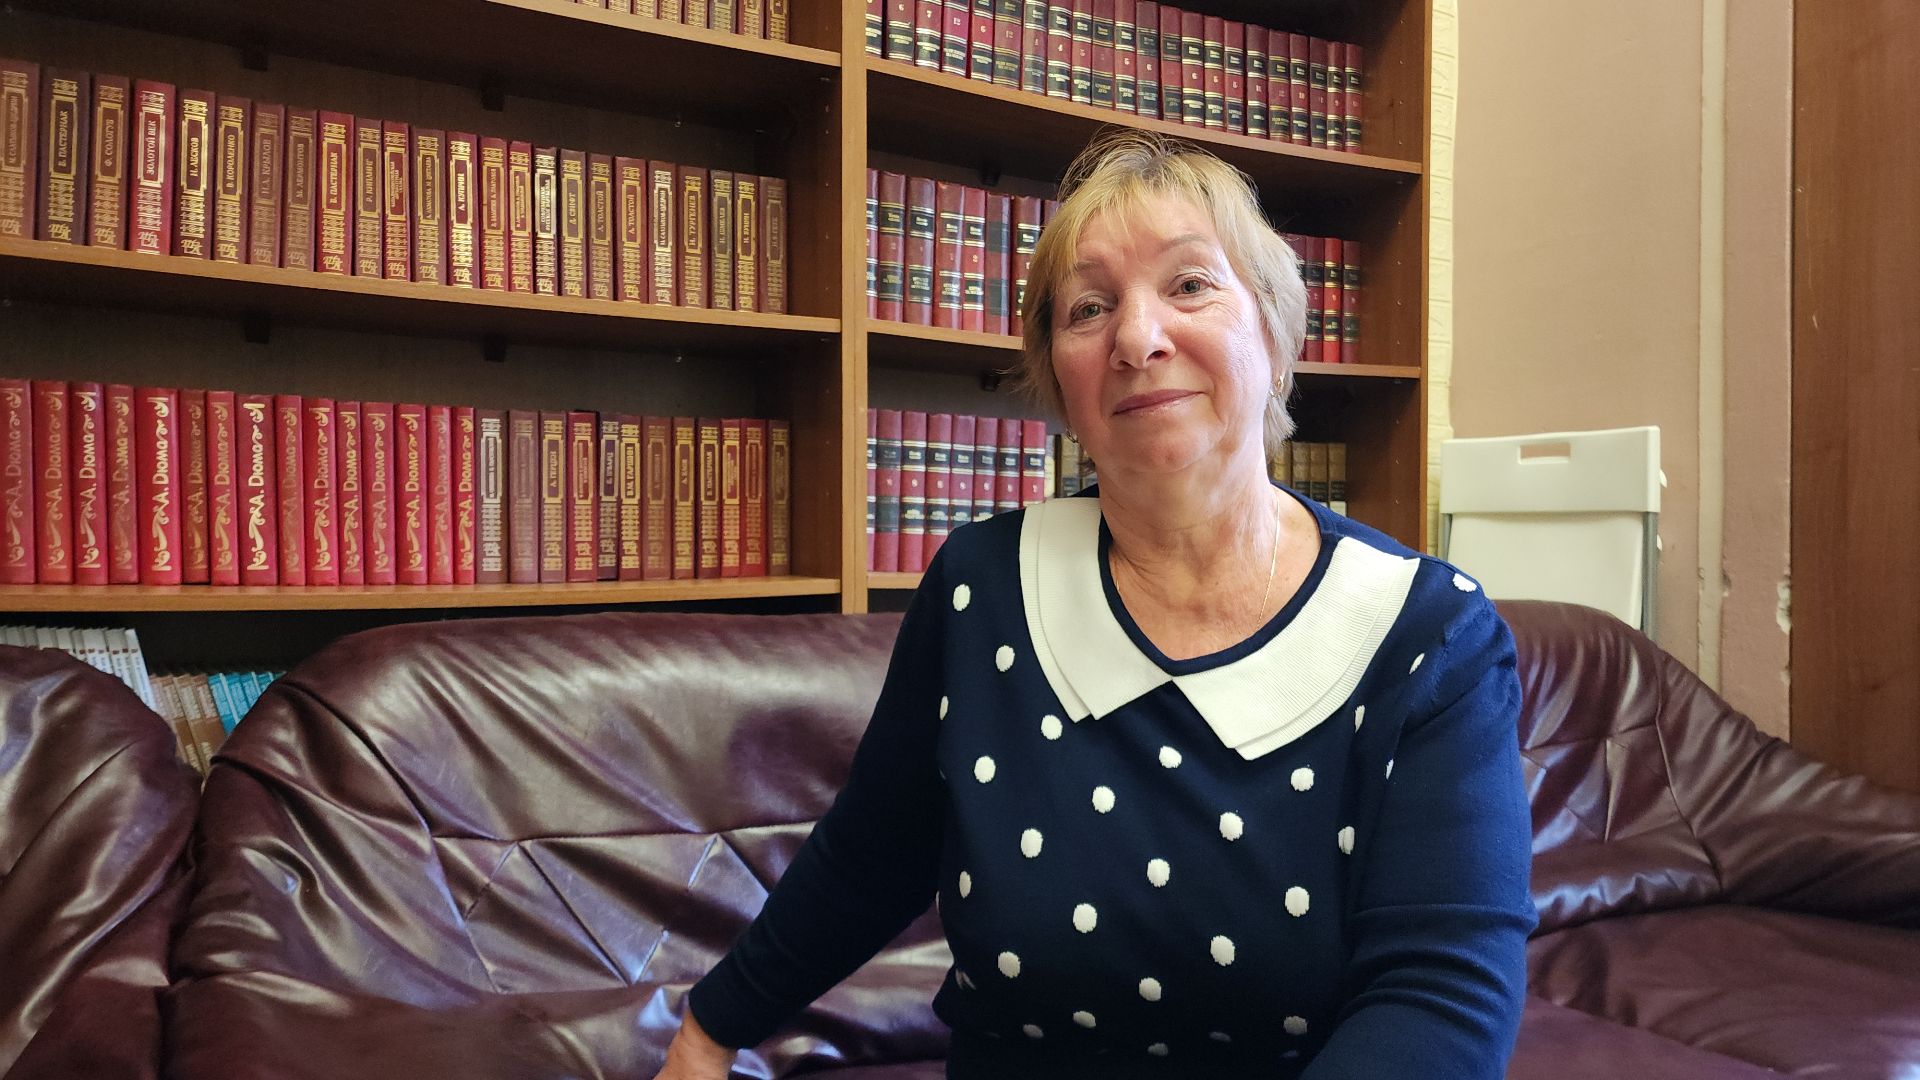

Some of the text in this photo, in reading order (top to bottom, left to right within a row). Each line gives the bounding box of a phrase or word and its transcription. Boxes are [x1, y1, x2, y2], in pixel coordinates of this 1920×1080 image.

[58, 110, 68, 157] ПАСТЕРНАК
[146, 120, 156, 175] ЗОЛОТОЙ ВЕК
[104, 158, 112, 166] Ф.
[190, 137, 199, 167] ЛЕСКОВ
[226, 134, 235, 180] КОРОЛЕНКО
[262, 139, 271, 175] КРЫЛОВ
[330, 152, 338, 195] ПАСТЕРНАК
[596, 190, 604, 223] ТОЛСТОЙ
[627, 194, 635, 226] ТОЛСТОЙ
